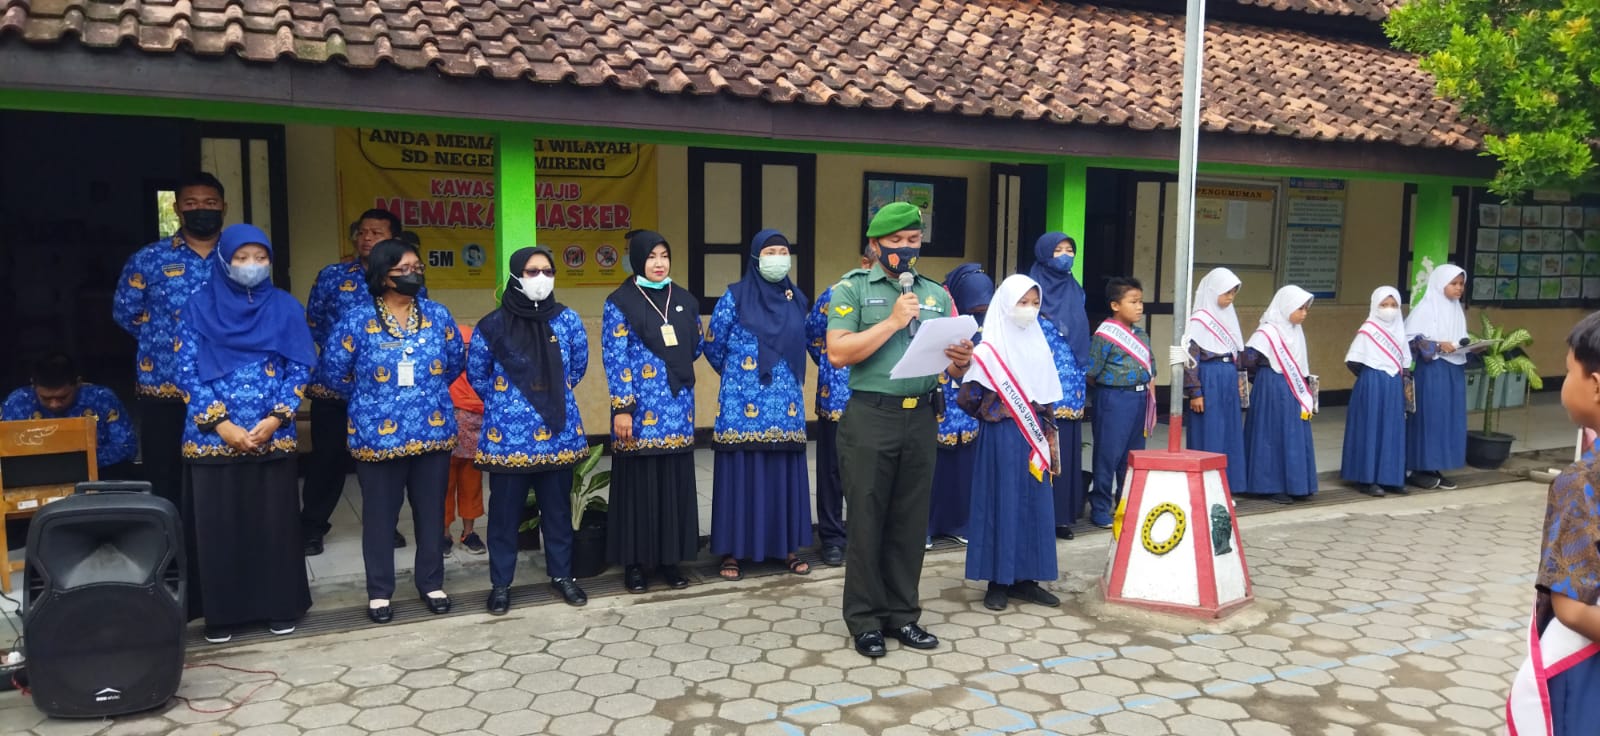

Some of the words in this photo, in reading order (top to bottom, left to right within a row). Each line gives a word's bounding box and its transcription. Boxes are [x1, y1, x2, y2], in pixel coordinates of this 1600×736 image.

[369, 128, 431, 147] ANDA
[549, 139, 632, 155] WILAYAH
[401, 149, 428, 164] SD
[434, 151, 494, 168] NEGE
[431, 179, 495, 197] KAWAS
[428, 250, 454, 267] 5M
[1001, 380, 1027, 414] PETUGAS
[1024, 411, 1044, 443] UPACARA
